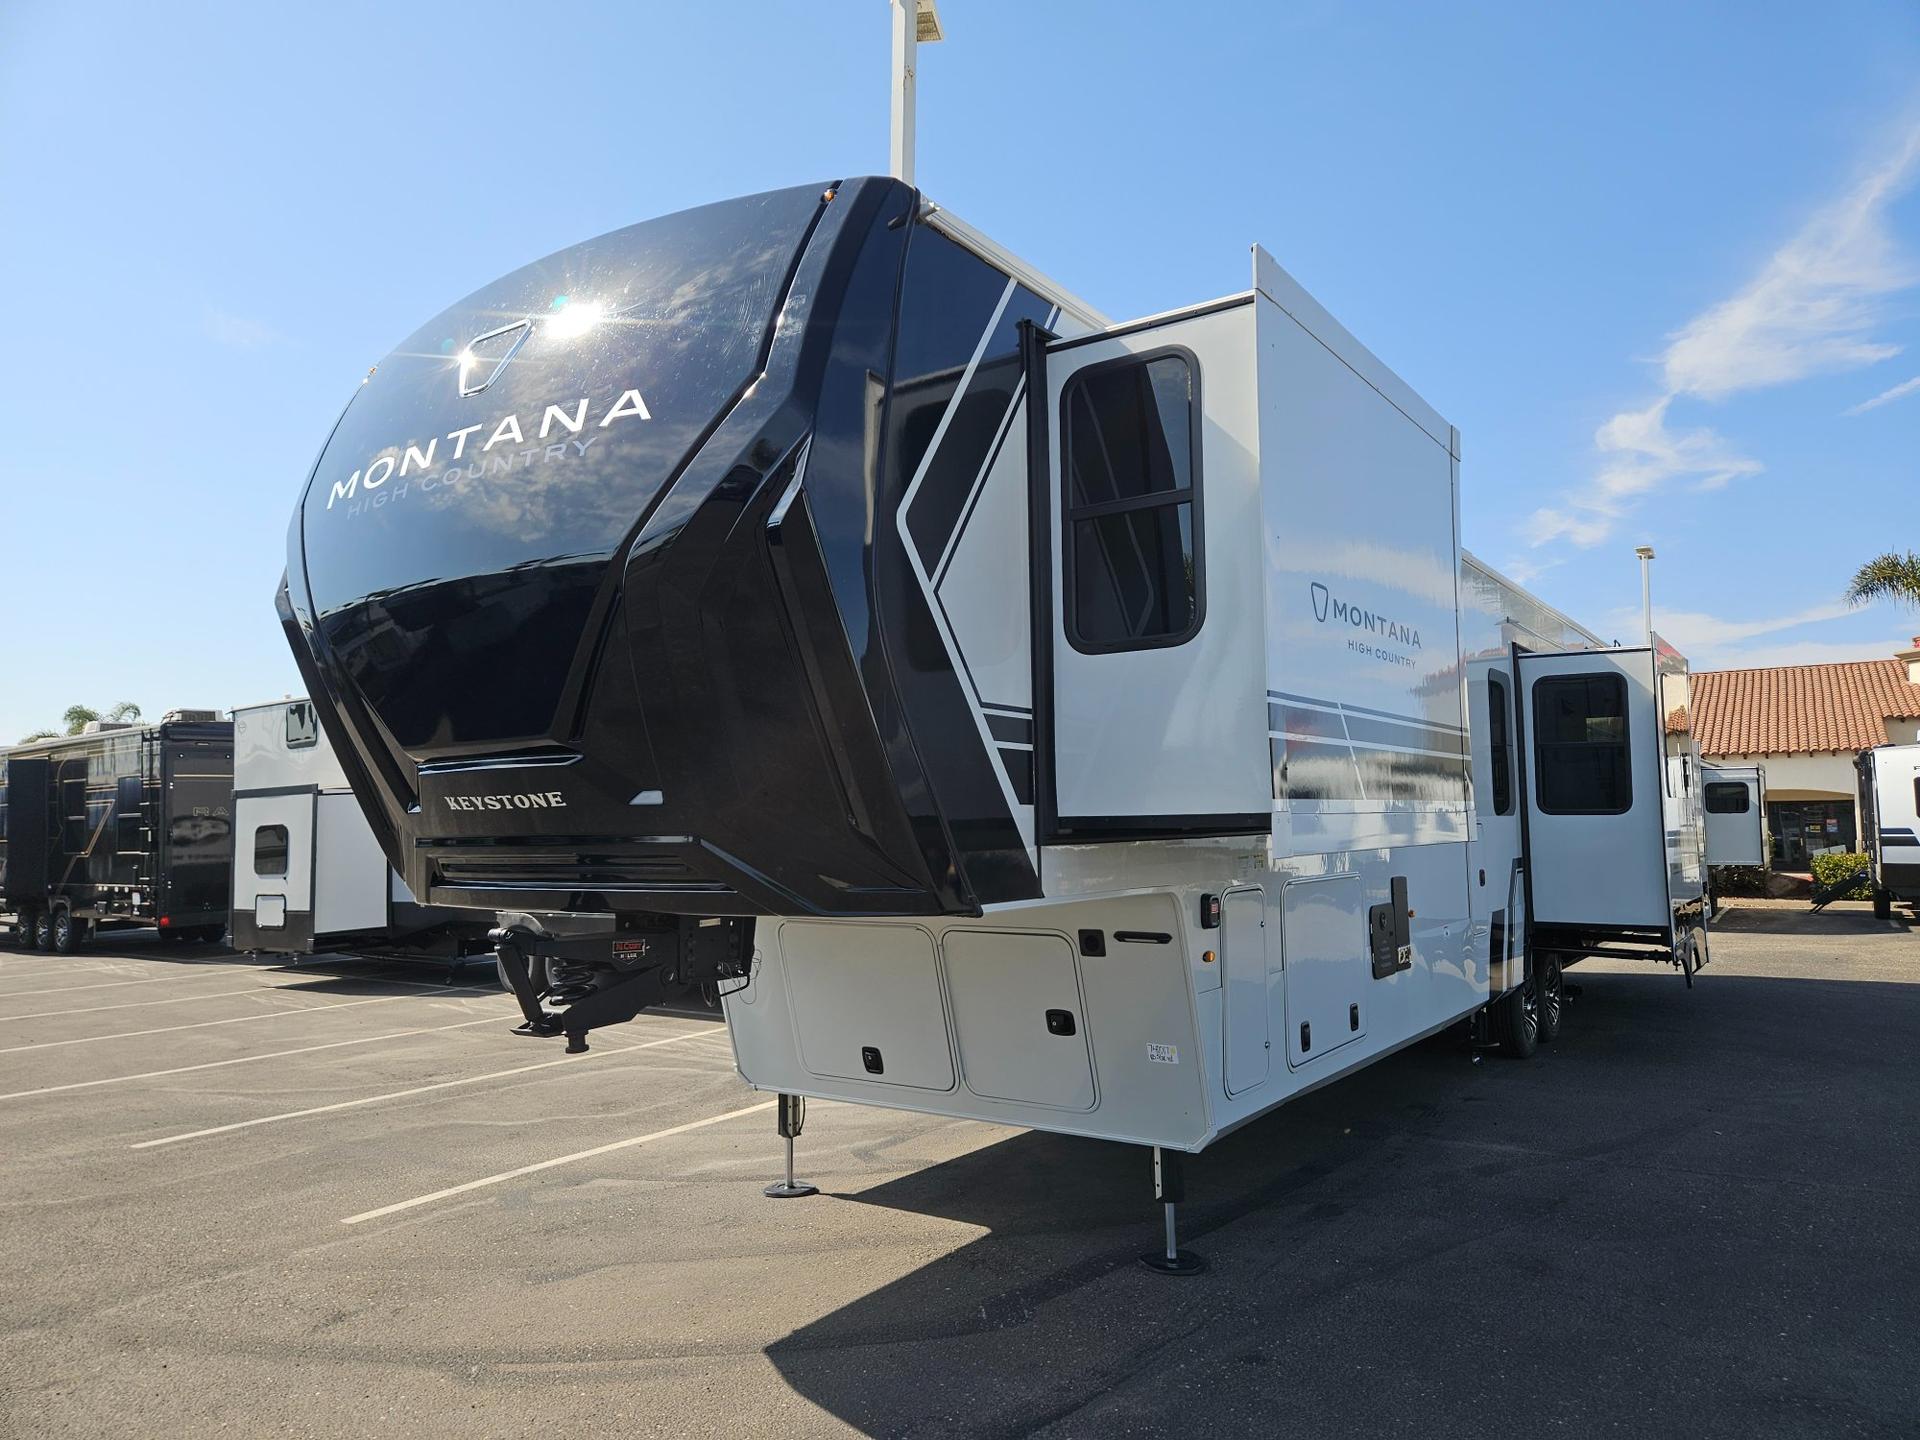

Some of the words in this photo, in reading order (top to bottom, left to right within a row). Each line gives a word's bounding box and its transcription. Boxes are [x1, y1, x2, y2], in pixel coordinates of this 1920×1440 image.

[327, 389, 651, 510] MONTANA
[347, 482, 409, 520] HIGH
[421, 437, 598, 492] COUNTRY
[1333, 598, 1422, 649] MONTANA
[1348, 639, 1372, 657] HIGH
[1375, 648, 1417, 670] COUNTRY
[444, 791, 567, 811] KEYSTONE
